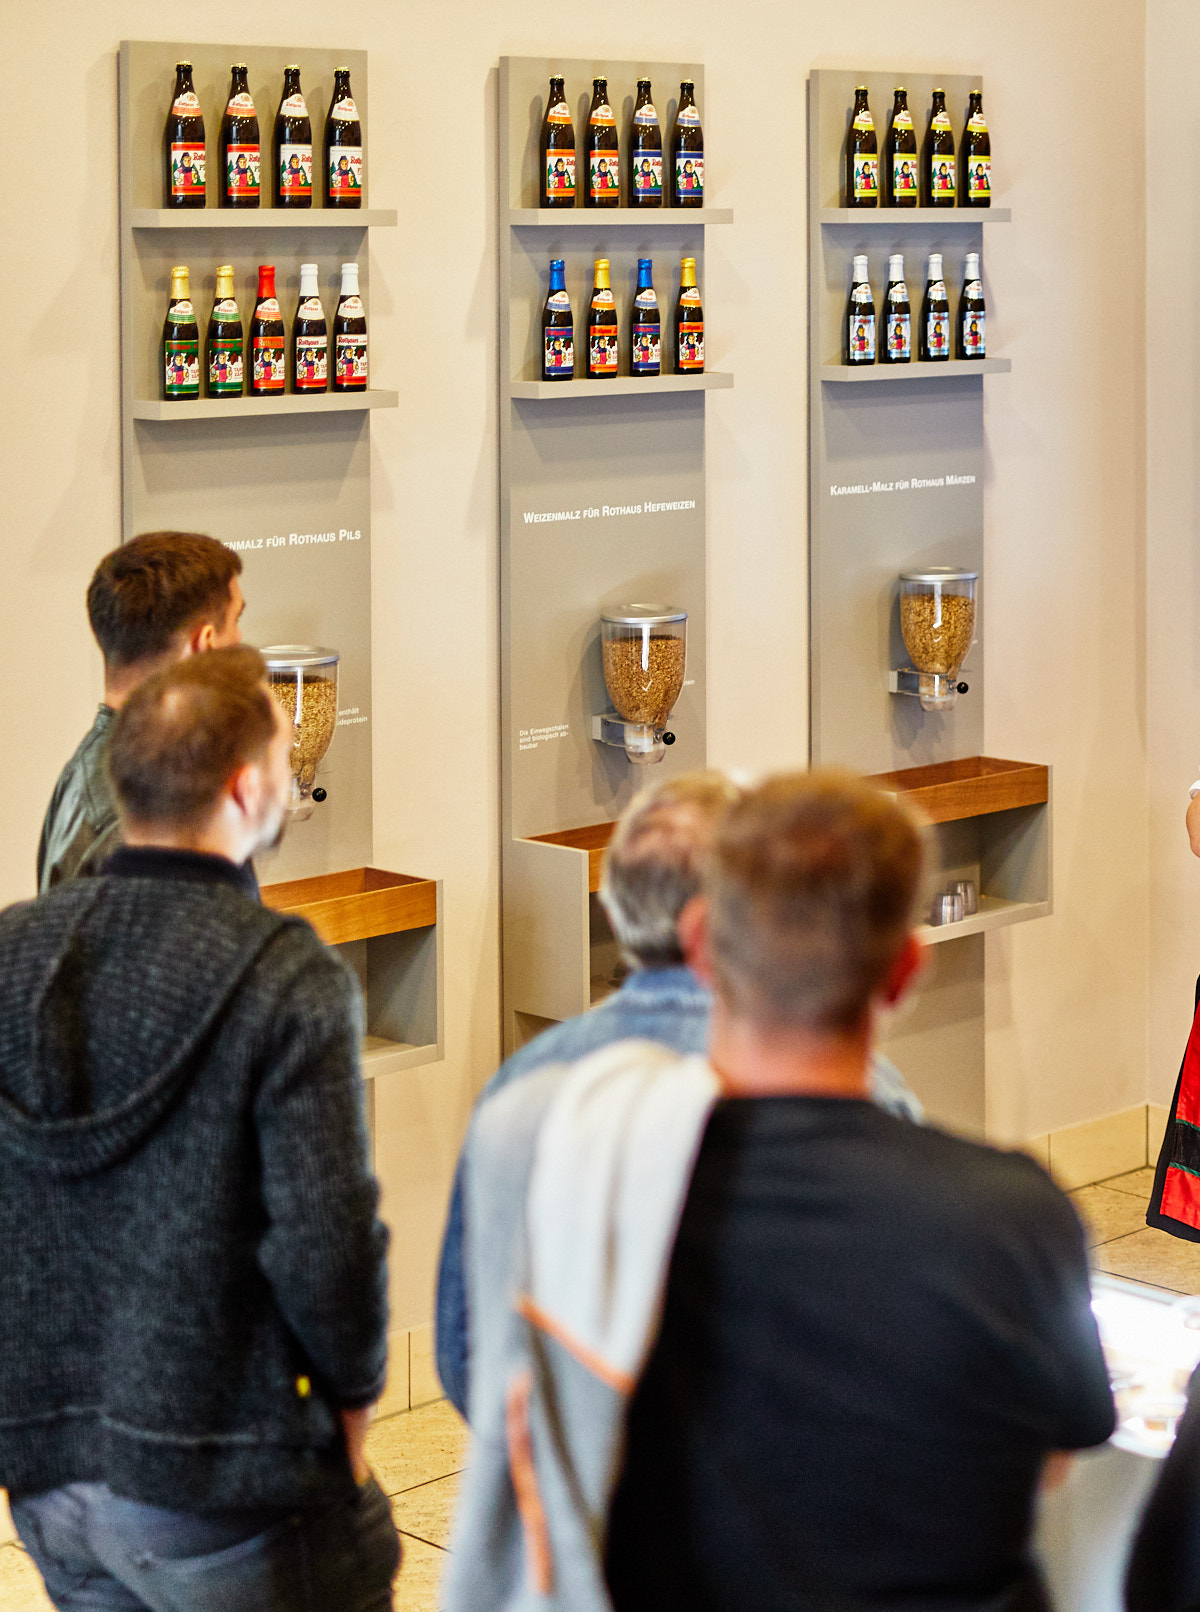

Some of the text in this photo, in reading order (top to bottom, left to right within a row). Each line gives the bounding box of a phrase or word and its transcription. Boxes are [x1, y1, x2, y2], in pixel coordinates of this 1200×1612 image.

[602, 505, 642, 517] ROTHAUS
[289, 532, 336, 545] ROTHAUS
[339, 529, 361, 541] PILS
